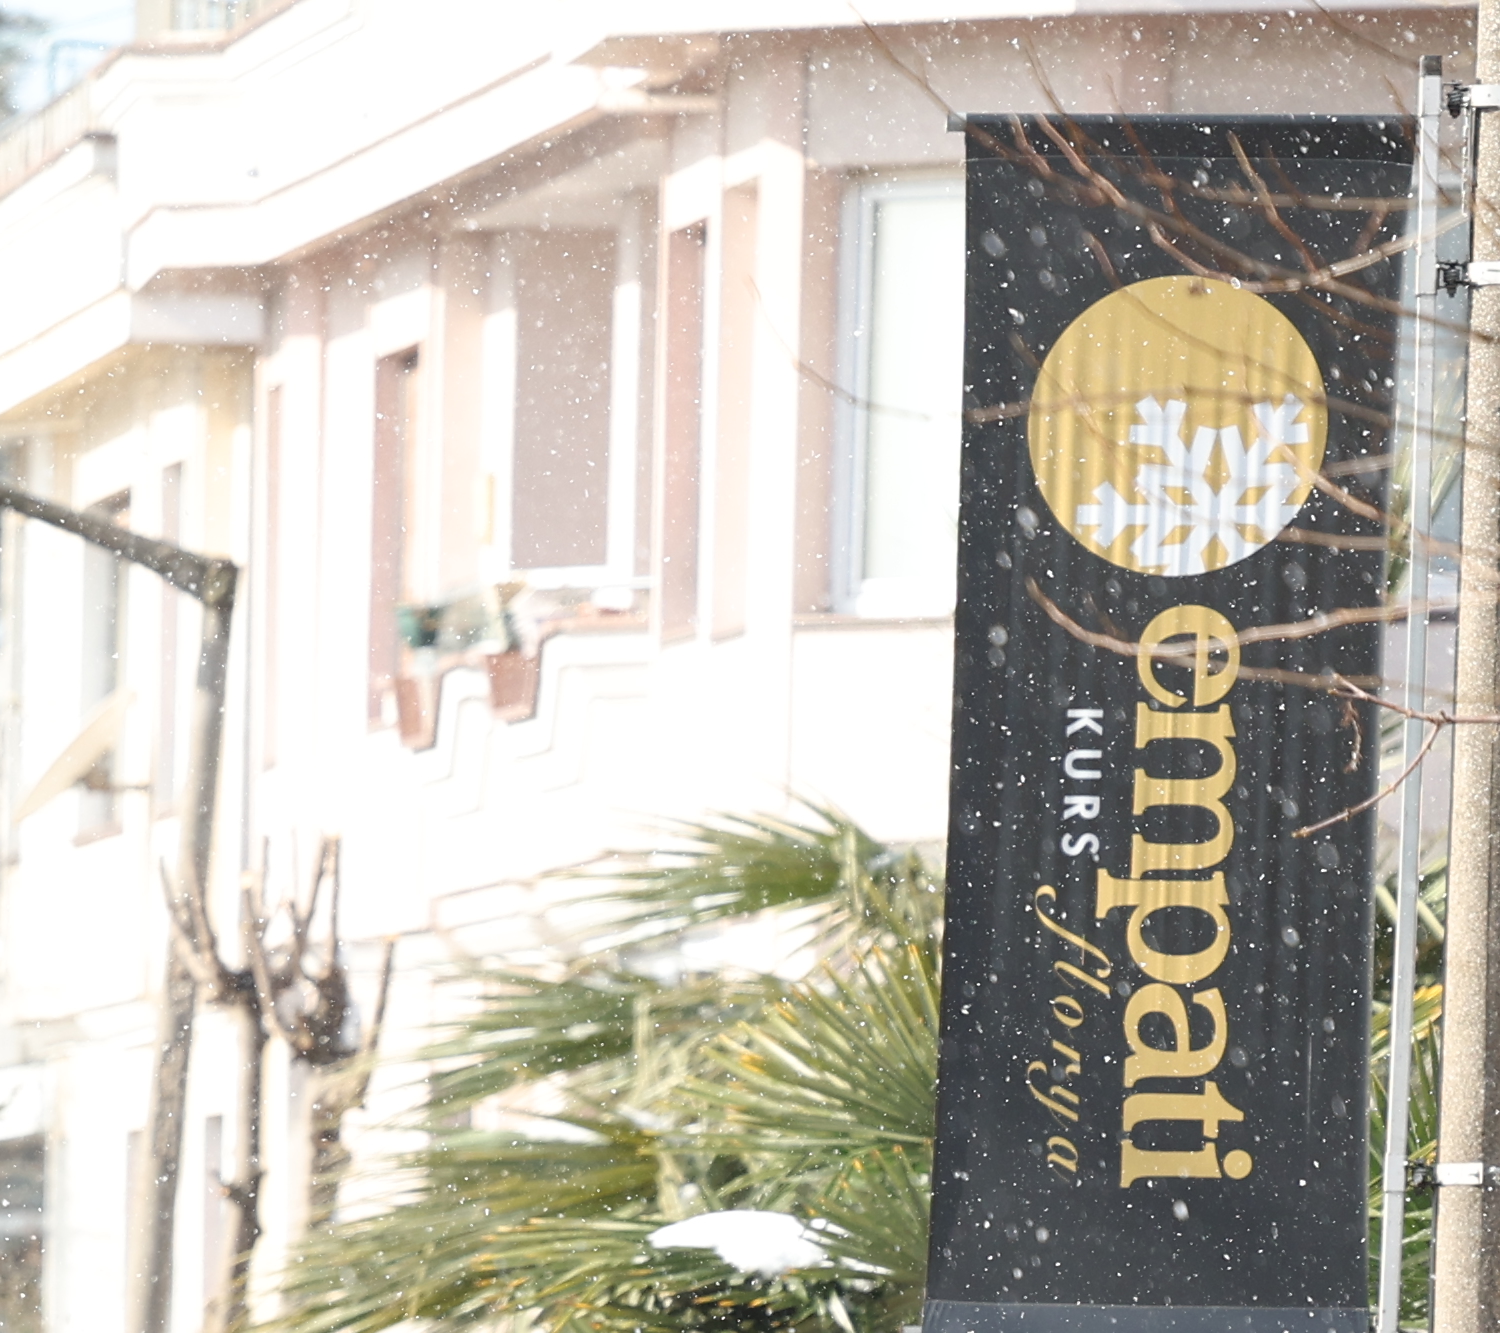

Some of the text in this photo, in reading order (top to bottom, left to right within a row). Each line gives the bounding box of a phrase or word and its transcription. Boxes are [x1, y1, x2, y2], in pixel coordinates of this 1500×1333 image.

[1026, 708, 1111, 1184] KURS florya
[1095, 604, 1253, 1188] empati
